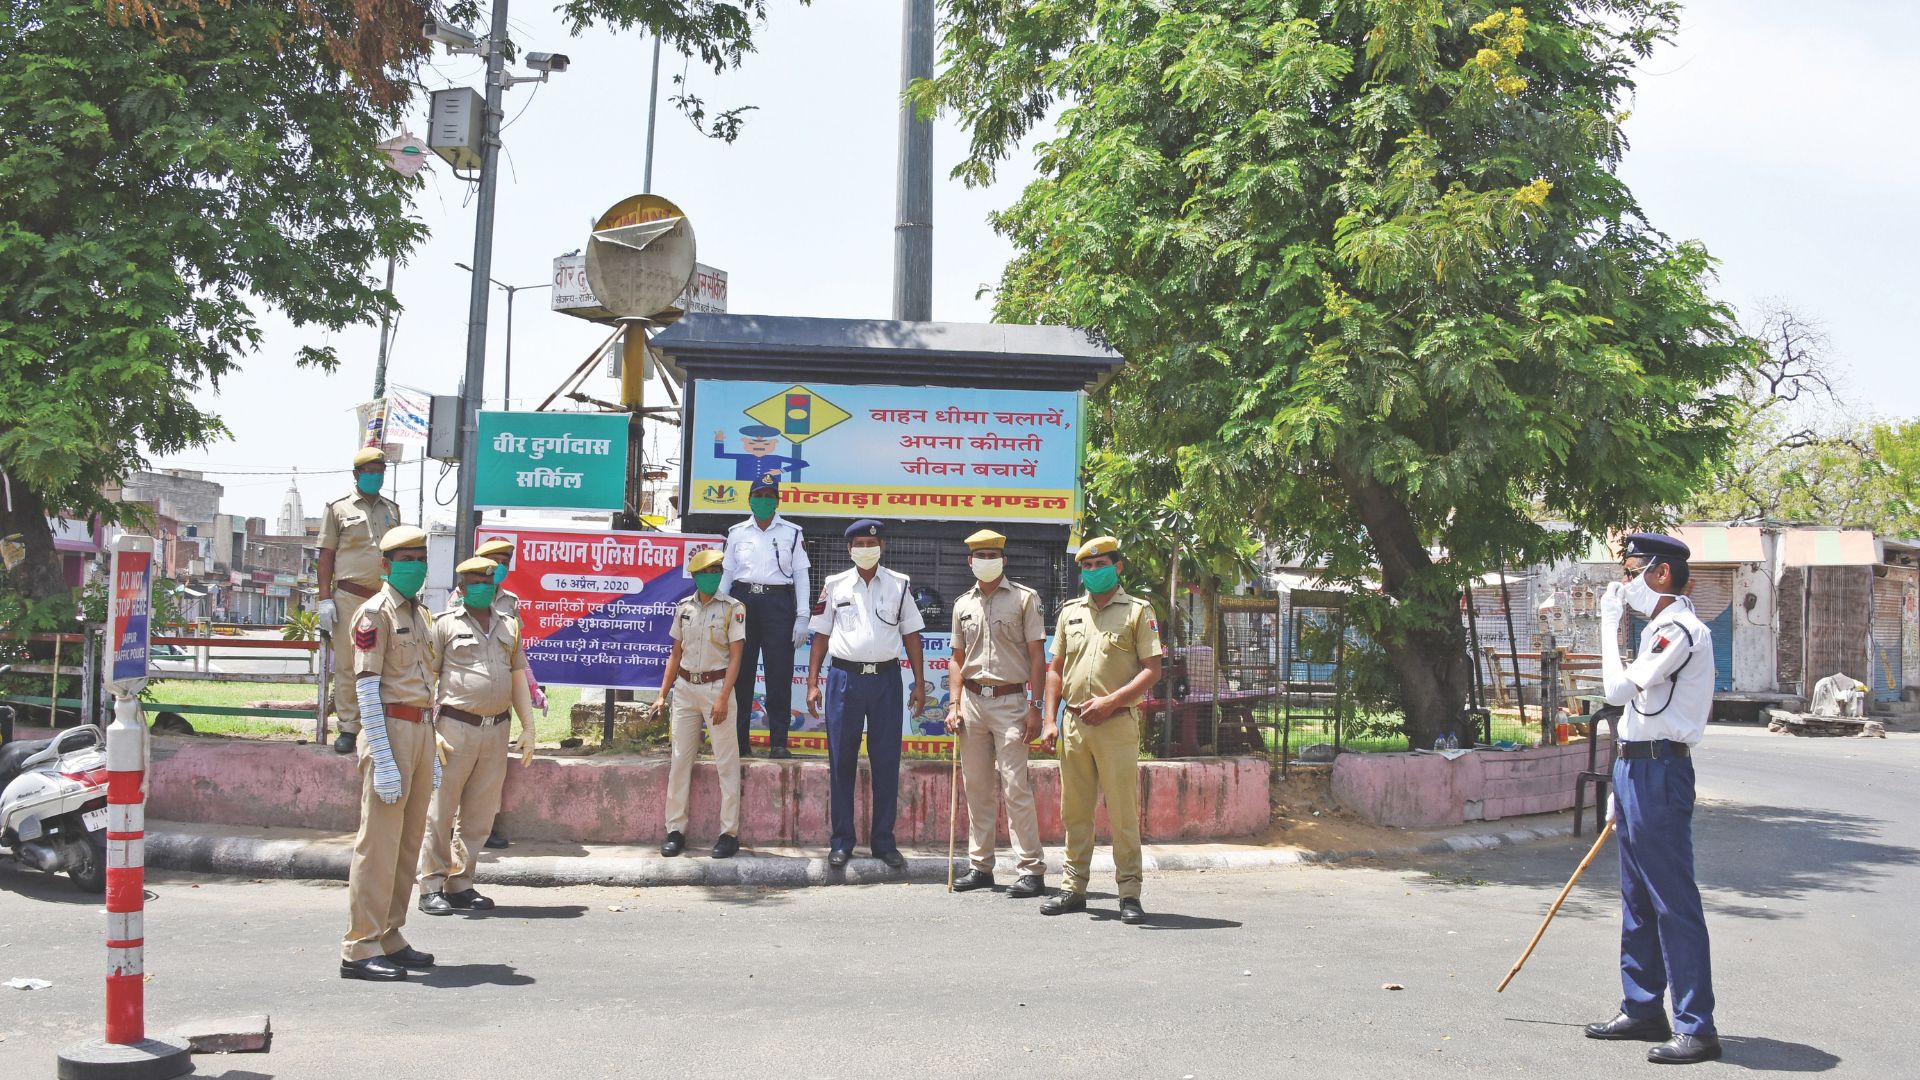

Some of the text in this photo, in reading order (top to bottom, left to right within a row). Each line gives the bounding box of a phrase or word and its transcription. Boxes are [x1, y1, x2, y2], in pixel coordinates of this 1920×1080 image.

[868, 406, 1071, 430] वाहन धीमा चलायें,
[493, 432, 611, 460] वीर दुर्गादास
[899, 432, 1043, 451] अपना कीमती
[900, 456, 1039, 478] जीवन बचायें
[516, 466, 584, 489] सर्किल
[887, 493, 976, 508] व्यापार
[981, 495, 1070, 510] मण्डल
[522, 540, 588, 566] राजस्थान
[591, 537, 636, 572] पुलिस
[636, 538, 679, 568] दिवस
[121, 571, 144, 590] DO NOT
[555, 578, 567, 588] 16
[604, 581, 629, 591] 2020
[131, 599, 146, 616] HERE
[535, 597, 585, 612] नागरिकों
[587, 599, 605, 615] एवं
[539, 613, 575, 628] हार्दिक
[566, 637, 586, 652] घड़ी
[588, 637, 599, 650] में
[602, 641, 620, 651] हम
[130, 647, 145, 661] POLICE
[561, 650, 578, 663] एवं
[580, 652, 622, 667] सुरक्षित
[625, 654, 658, 666] जीवन
